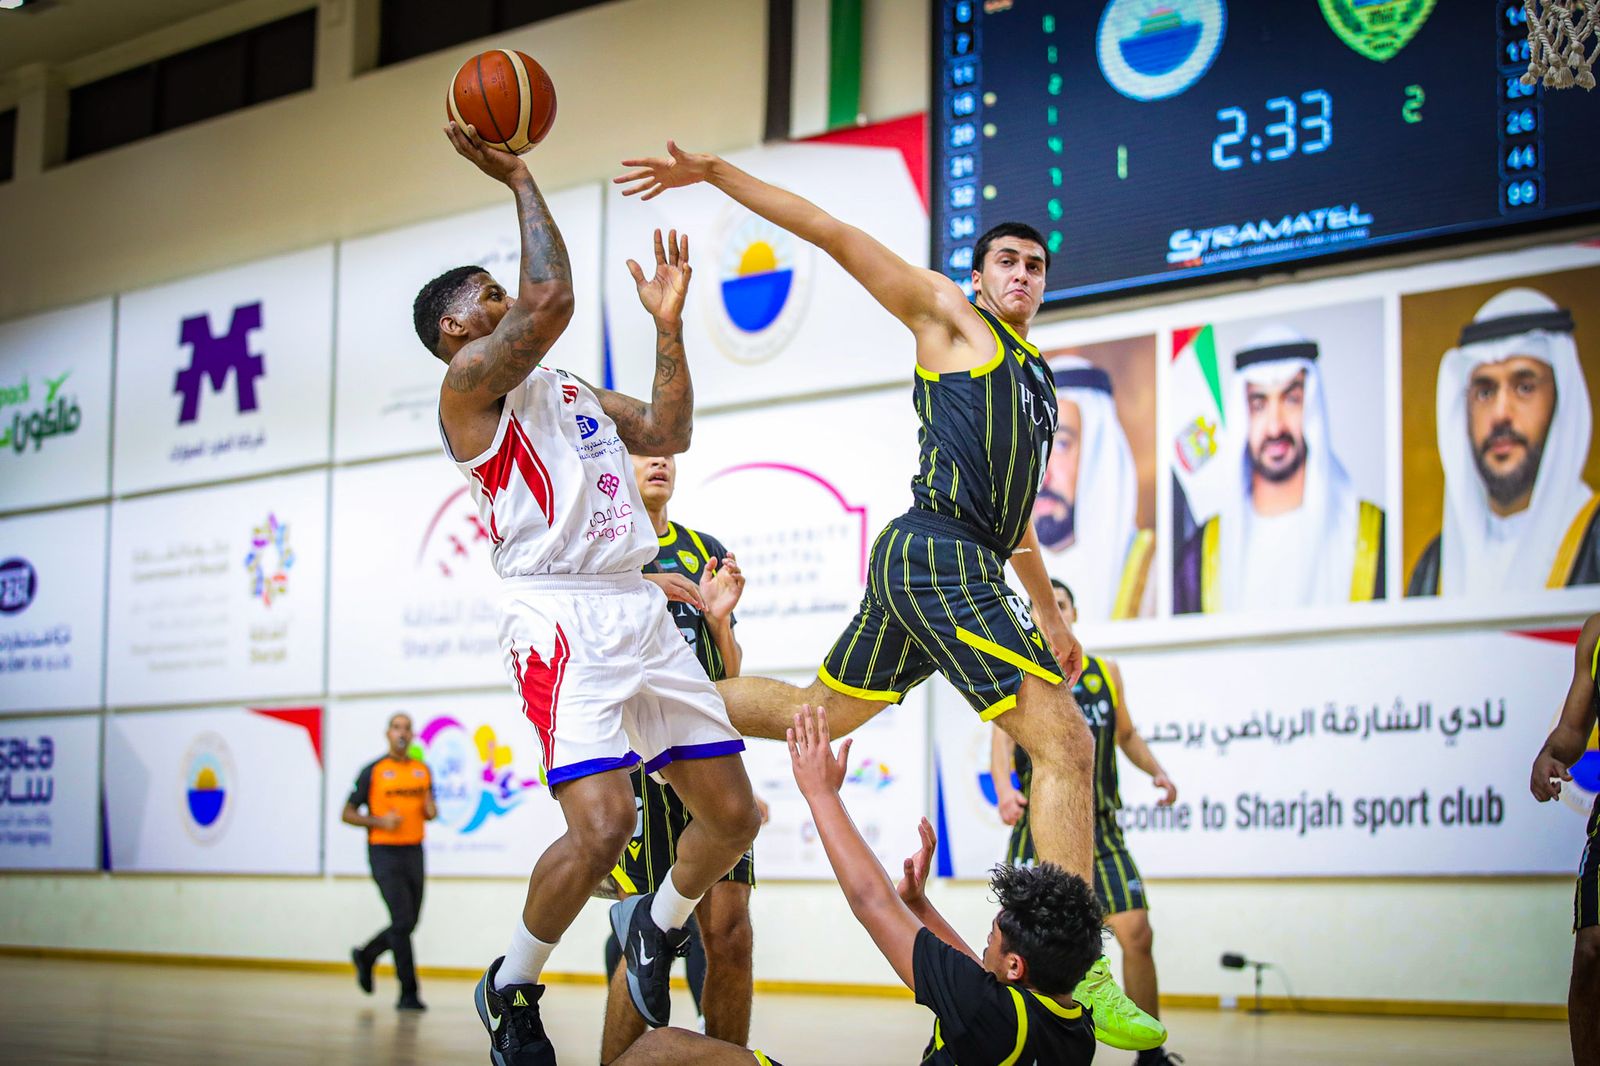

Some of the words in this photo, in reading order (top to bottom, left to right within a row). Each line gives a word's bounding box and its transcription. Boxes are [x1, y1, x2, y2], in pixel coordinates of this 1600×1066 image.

[1402, 84, 1426, 124] 2
[1212, 89, 1333, 171] 2:33
[1166, 202, 1374, 265] STRAMATEL
[1210, 707, 1316, 756] الرياضي
[1321, 696, 1432, 742] الشارقة
[1438, 698, 1507, 747] نادي
[1201, 796, 1227, 831] to
[1235, 791, 1343, 837] Sharjah
[1353, 789, 1430, 837] sport
[1440, 785, 1506, 826] club
